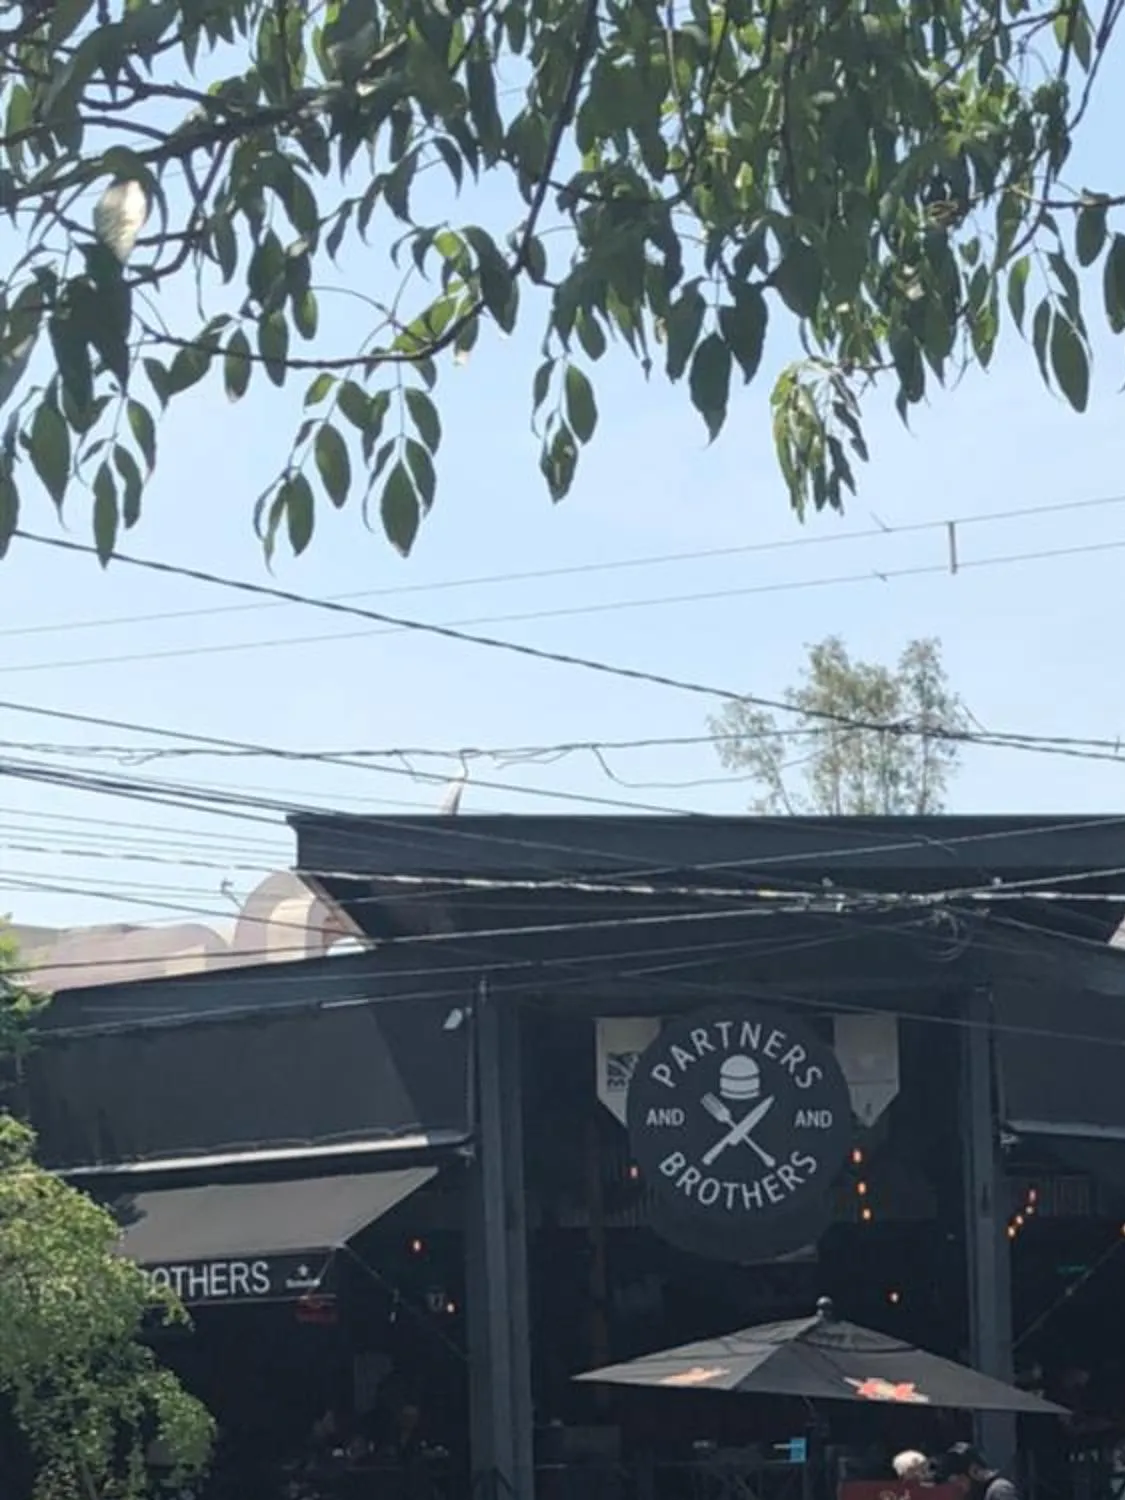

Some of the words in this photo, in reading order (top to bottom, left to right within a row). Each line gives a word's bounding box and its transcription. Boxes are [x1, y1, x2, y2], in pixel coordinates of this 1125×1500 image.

[651, 1020, 824, 1089] PARTNERS
[645, 1107, 685, 1127] AND
[794, 1109, 833, 1128] AND
[658, 1150, 818, 1210] BROTHERS
[139, 1261, 270, 1298] OTHERS
